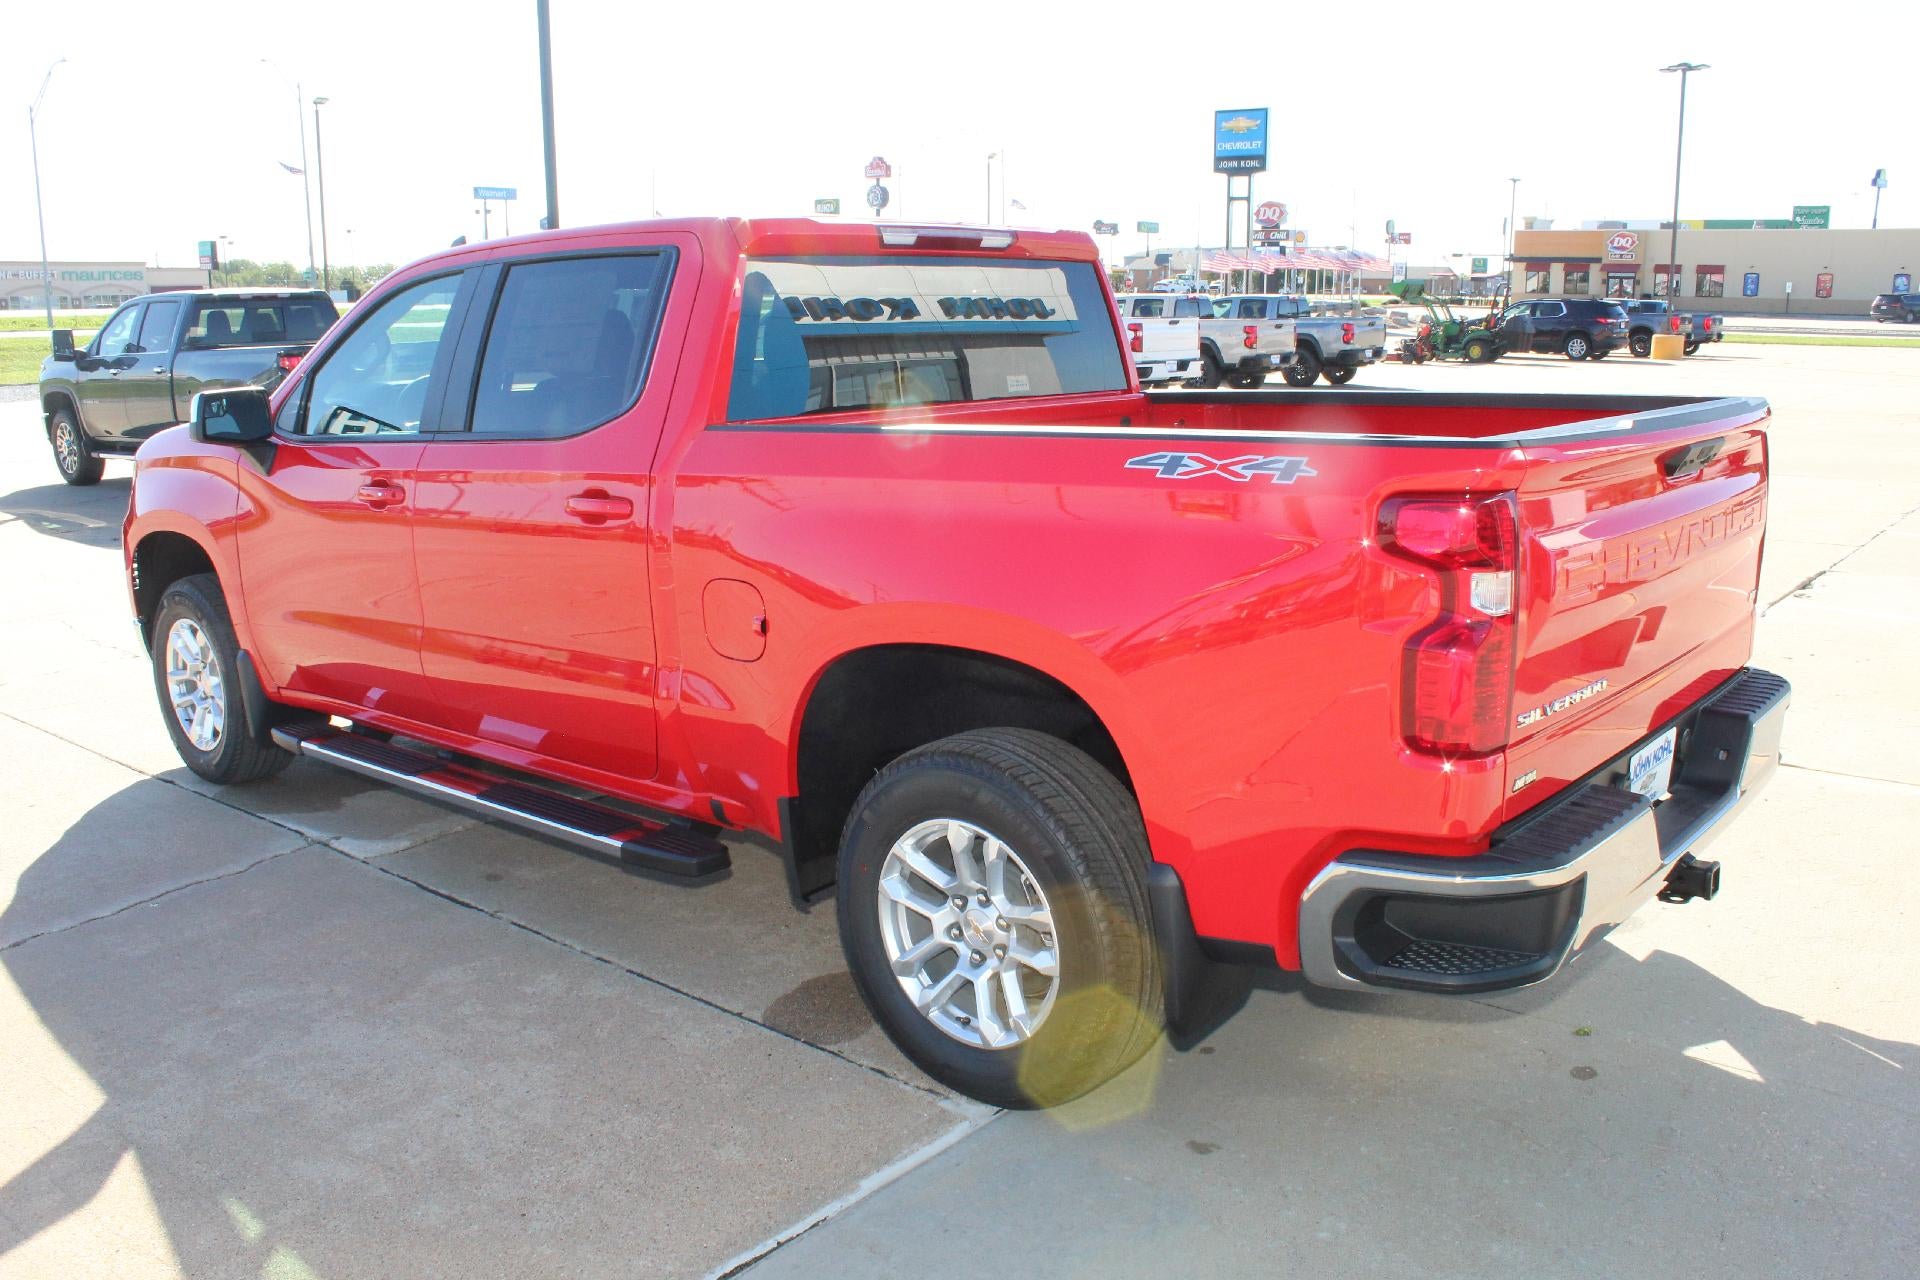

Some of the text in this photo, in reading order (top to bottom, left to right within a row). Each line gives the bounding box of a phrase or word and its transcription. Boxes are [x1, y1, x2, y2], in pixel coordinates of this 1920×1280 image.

[1217, 141, 1262, 151] CHEVROLET
[1219, 160, 1260, 168] JOHN KOHL
[480, 189, 507, 198] Walmart
[1258, 206, 1281, 220] DQ
[1613, 236, 1633, 248] DQ
[61, 270, 144, 281] maurices
[1562, 495, 1766, 599] CHEVROLET
[1516, 677, 1608, 729] SILVERADO
[1632, 740, 1673, 783] JOHN KOHL
